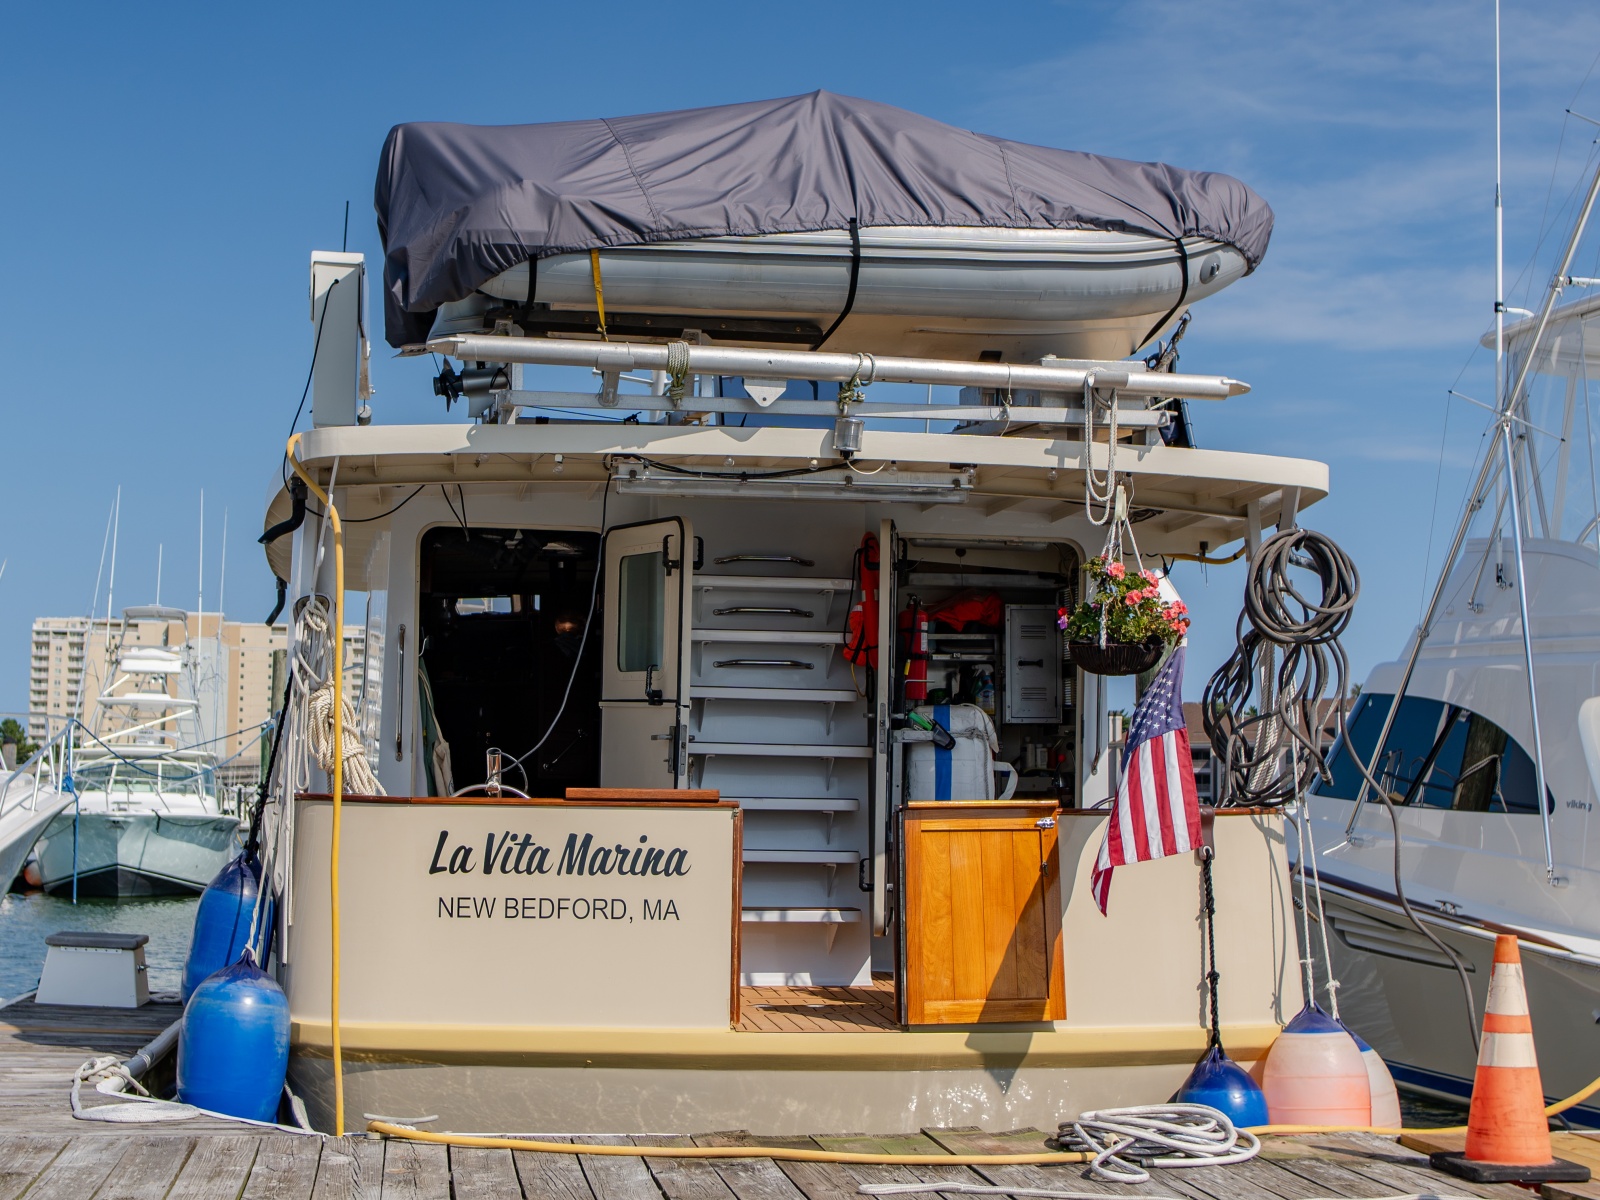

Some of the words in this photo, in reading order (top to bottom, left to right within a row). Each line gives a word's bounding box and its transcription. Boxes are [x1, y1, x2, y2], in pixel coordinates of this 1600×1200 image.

[429, 830, 477, 875] La
[483, 830, 554, 876] Vita
[556, 832, 692, 877] Marina
[438, 896, 496, 919] NEW
[504, 897, 633, 924] BEDFORD,
[643, 898, 680, 920] MA
